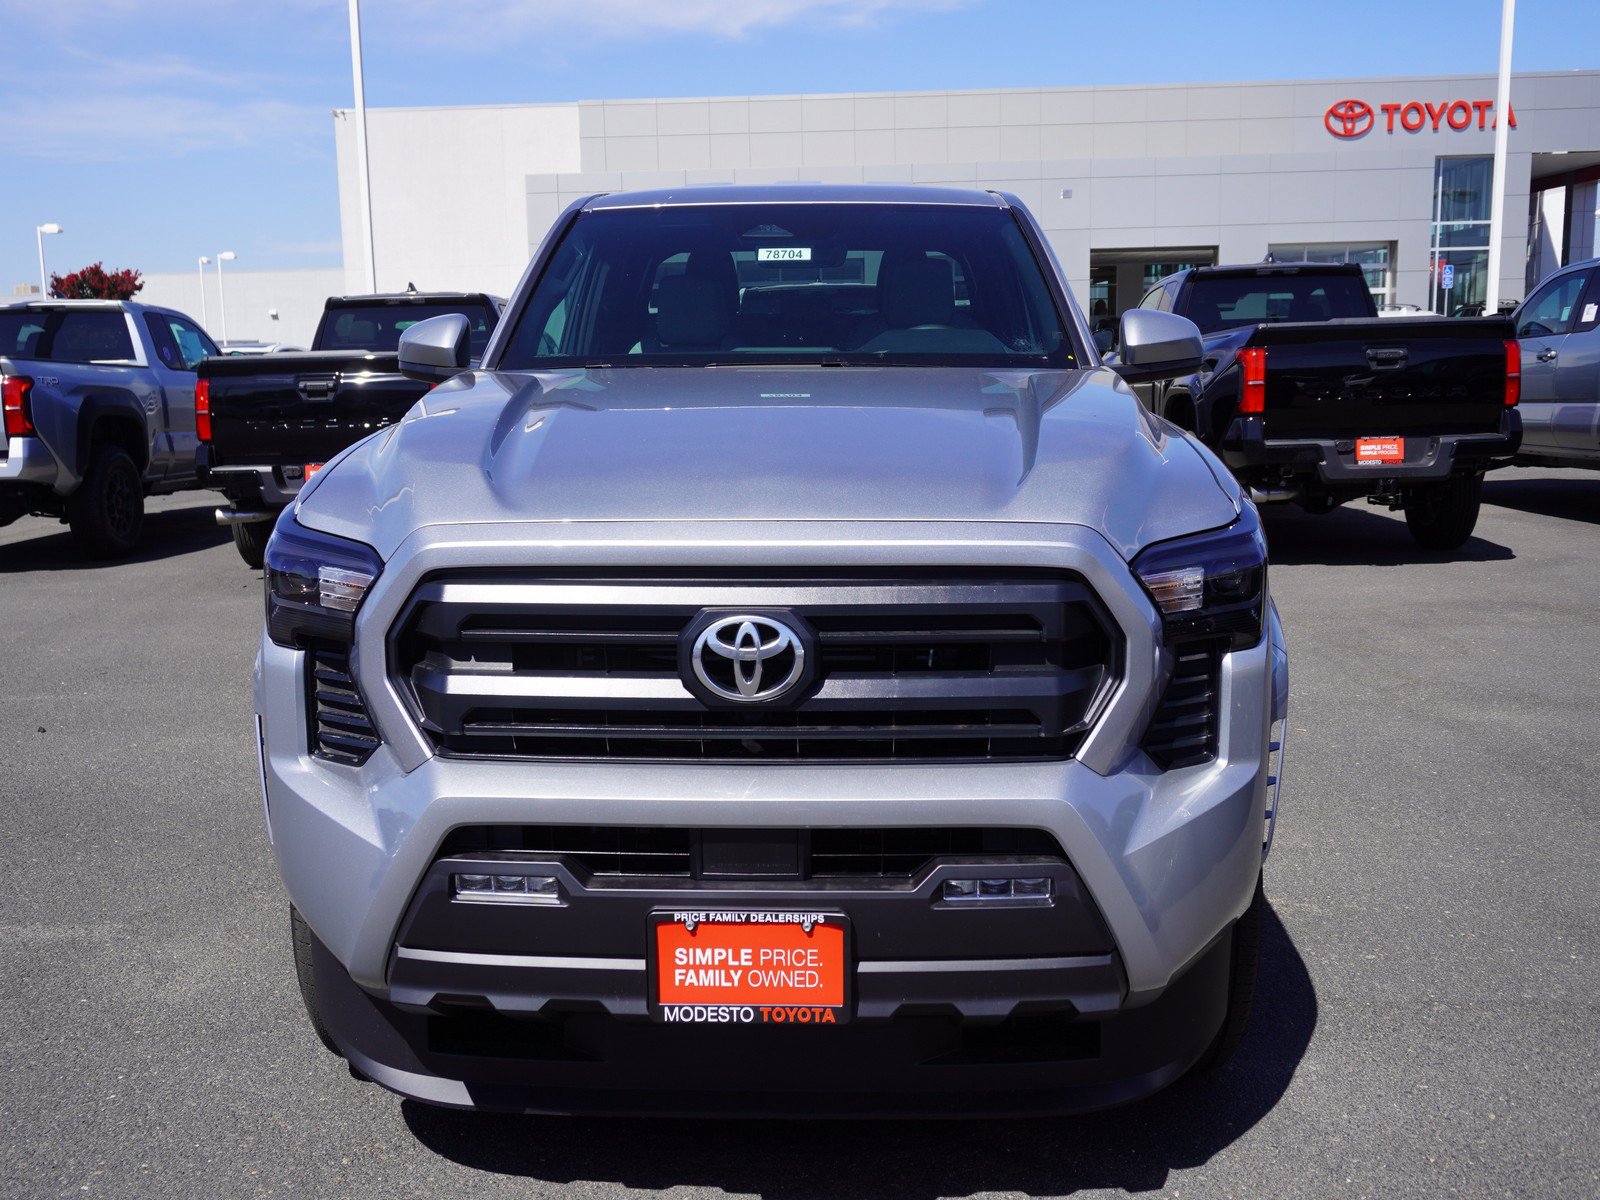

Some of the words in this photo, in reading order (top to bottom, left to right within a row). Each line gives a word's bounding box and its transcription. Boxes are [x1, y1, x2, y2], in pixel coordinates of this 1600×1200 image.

[766, 250, 803, 259] 78704
[674, 913, 706, 922] PRICE
[709, 914, 747, 922] FAMILY
[750, 914, 825, 923] DEALERSHIPS
[675, 948, 752, 966] SIMPLE
[760, 949, 823, 966] PRICE.
[675, 969, 742, 987] FAMILY
[748, 970, 823, 988] OWNED.
[664, 1007, 754, 1022] MODESTO
[760, 1008, 836, 1023] TOYOTA
